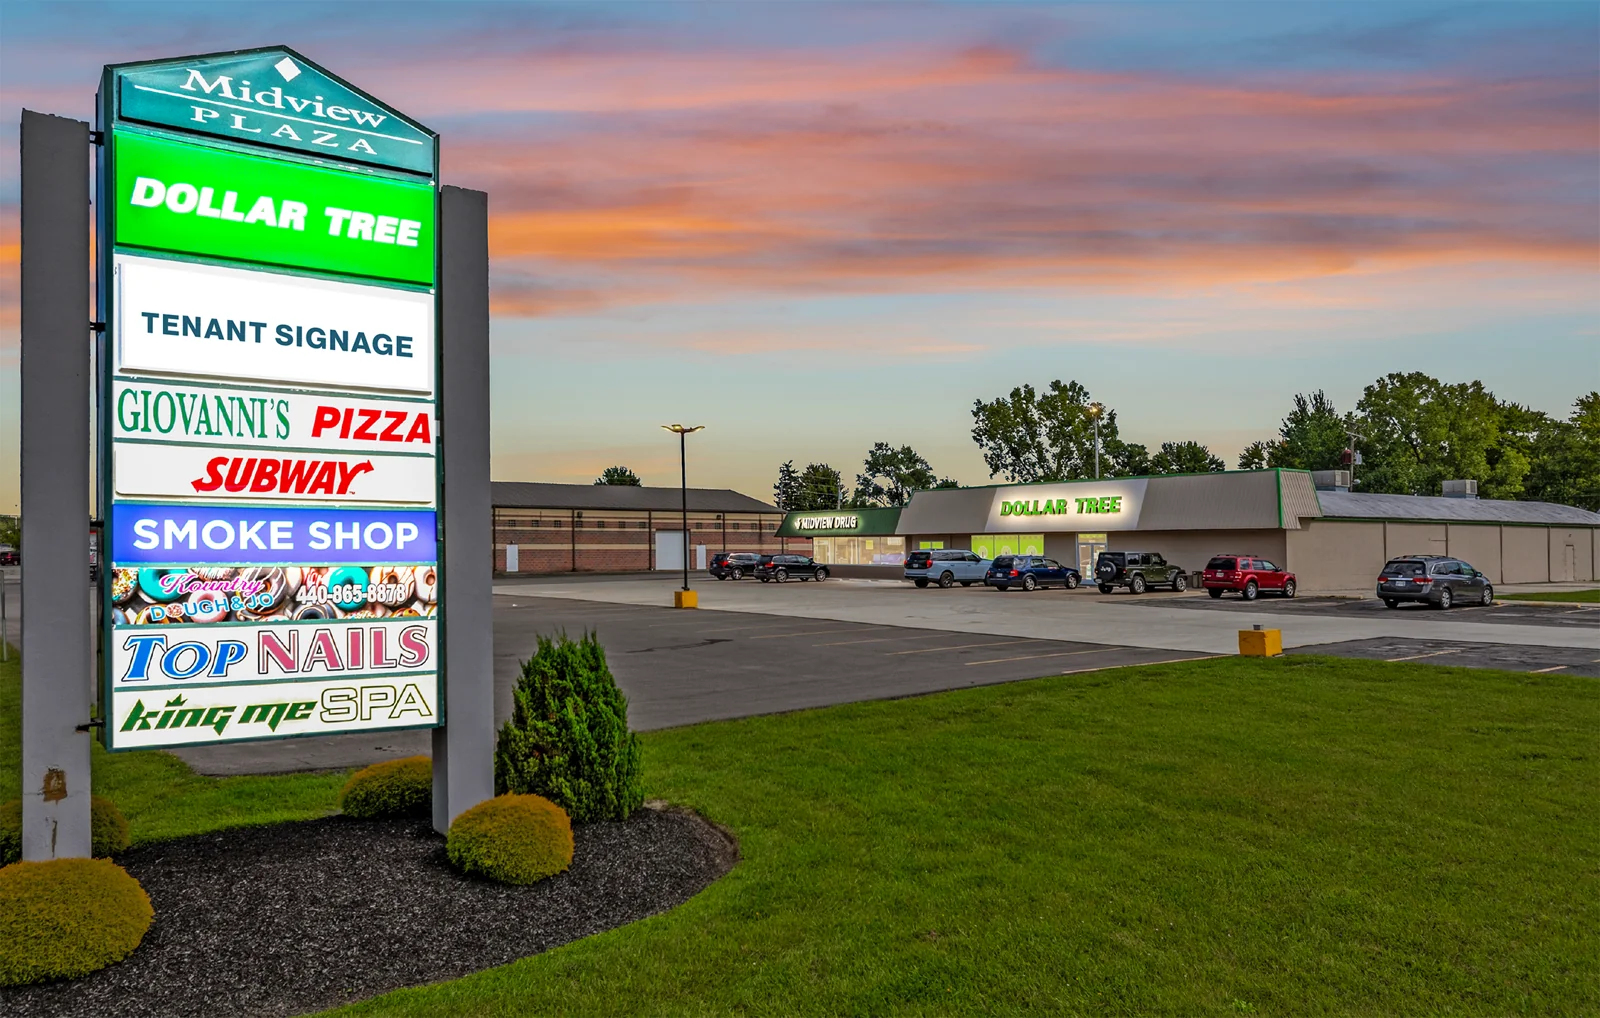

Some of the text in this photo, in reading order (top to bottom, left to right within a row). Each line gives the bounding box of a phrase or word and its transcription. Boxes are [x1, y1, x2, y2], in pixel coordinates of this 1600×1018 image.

[180, 68, 387, 128] Midview
[190, 105, 378, 155] PLAZA
[130, 176, 421, 247] DOLLAR TREE
[141, 311, 414, 358] TENANT SIGNAGE
[117, 388, 432, 444] GIOVANNI'S PIZZA
[191, 456, 375, 495] SUBWAY
[801, 515, 857, 529] MIDVIEW DRUG
[1000, 496, 1122, 516] DOLLAR TREE
[133, 518, 419, 551] SMOKE SHOP
[159, 573, 265, 596] Kountry
[297, 583, 407, 605] 440-865-8878
[257, 625, 430, 675] NAILS
[320, 684, 433, 723] SPA
